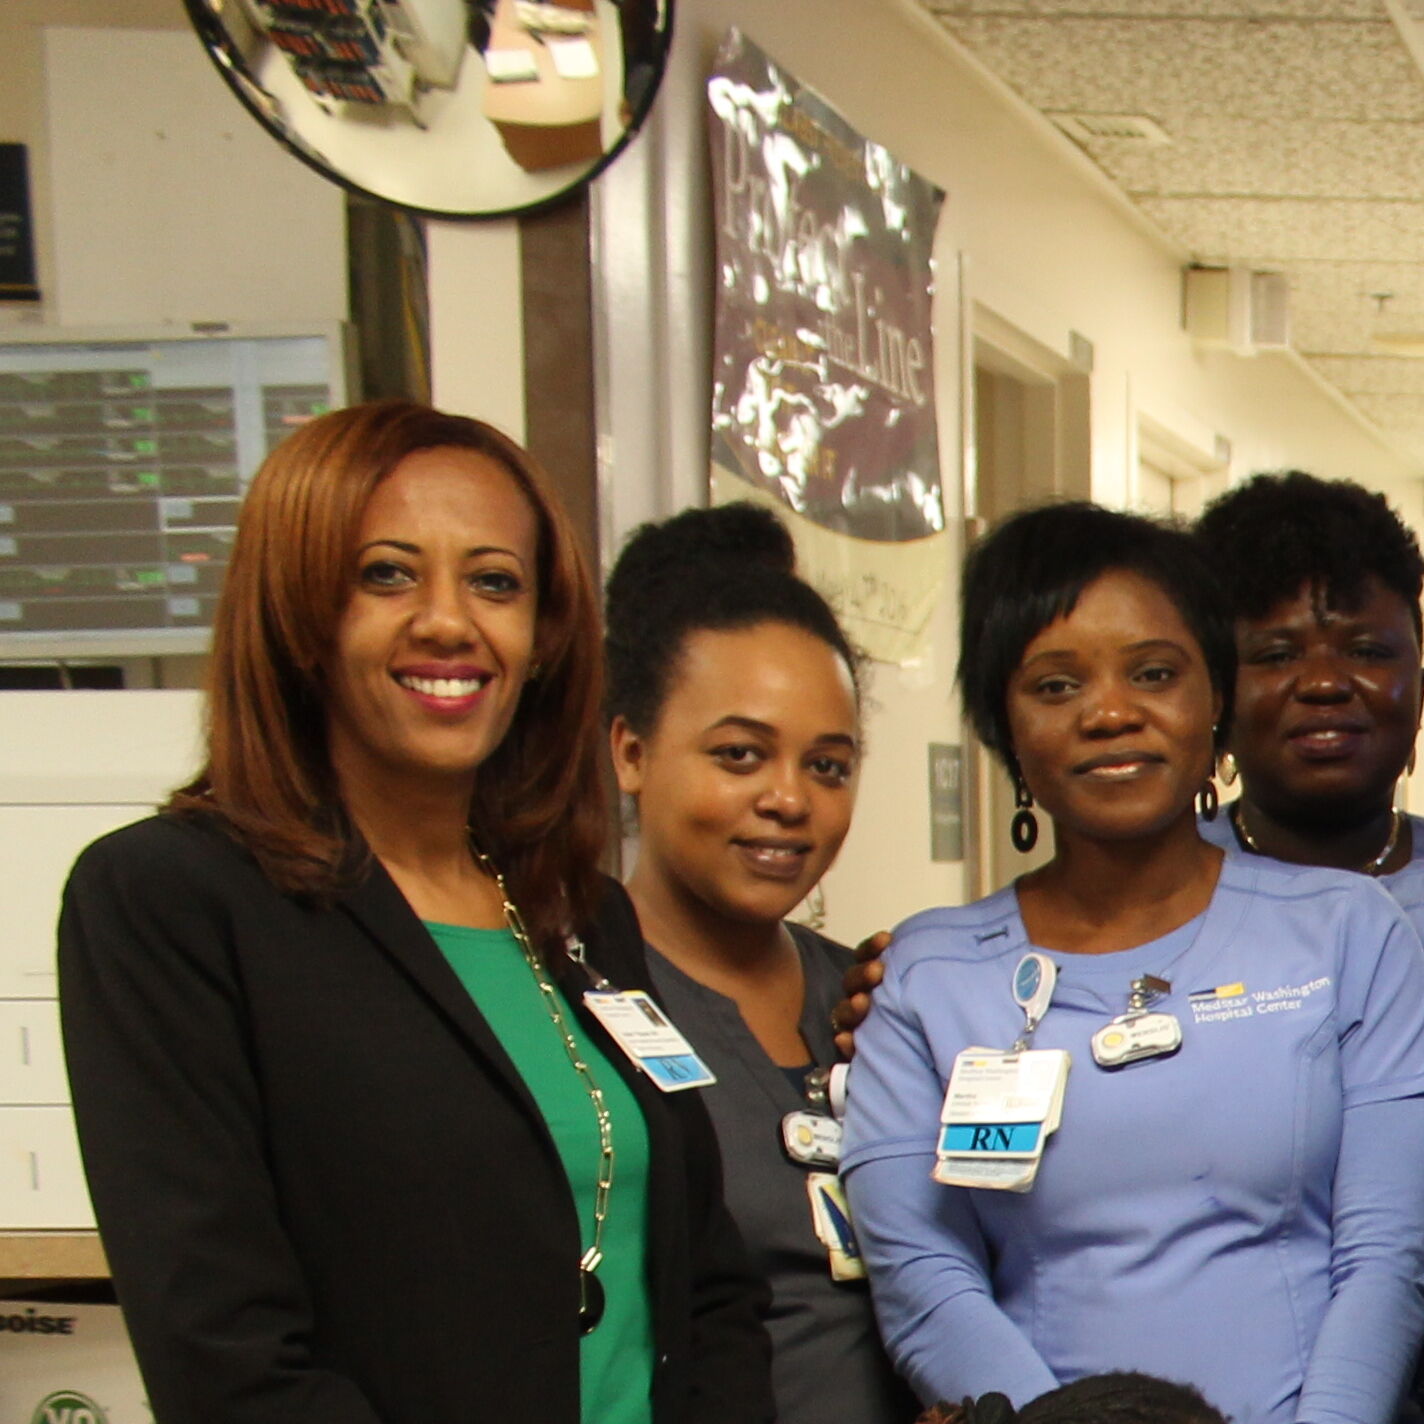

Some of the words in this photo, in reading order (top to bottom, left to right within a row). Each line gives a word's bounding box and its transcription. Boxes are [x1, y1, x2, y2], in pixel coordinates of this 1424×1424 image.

[856, 270, 926, 406] Line
[1191, 997, 1249, 1014] MedStar
[1251, 975, 1332, 1002] Washington
[1194, 1006, 1254, 1024] Hospital
[1256, 998, 1303, 1015] Center
[969, 1127, 1015, 1151] RN
